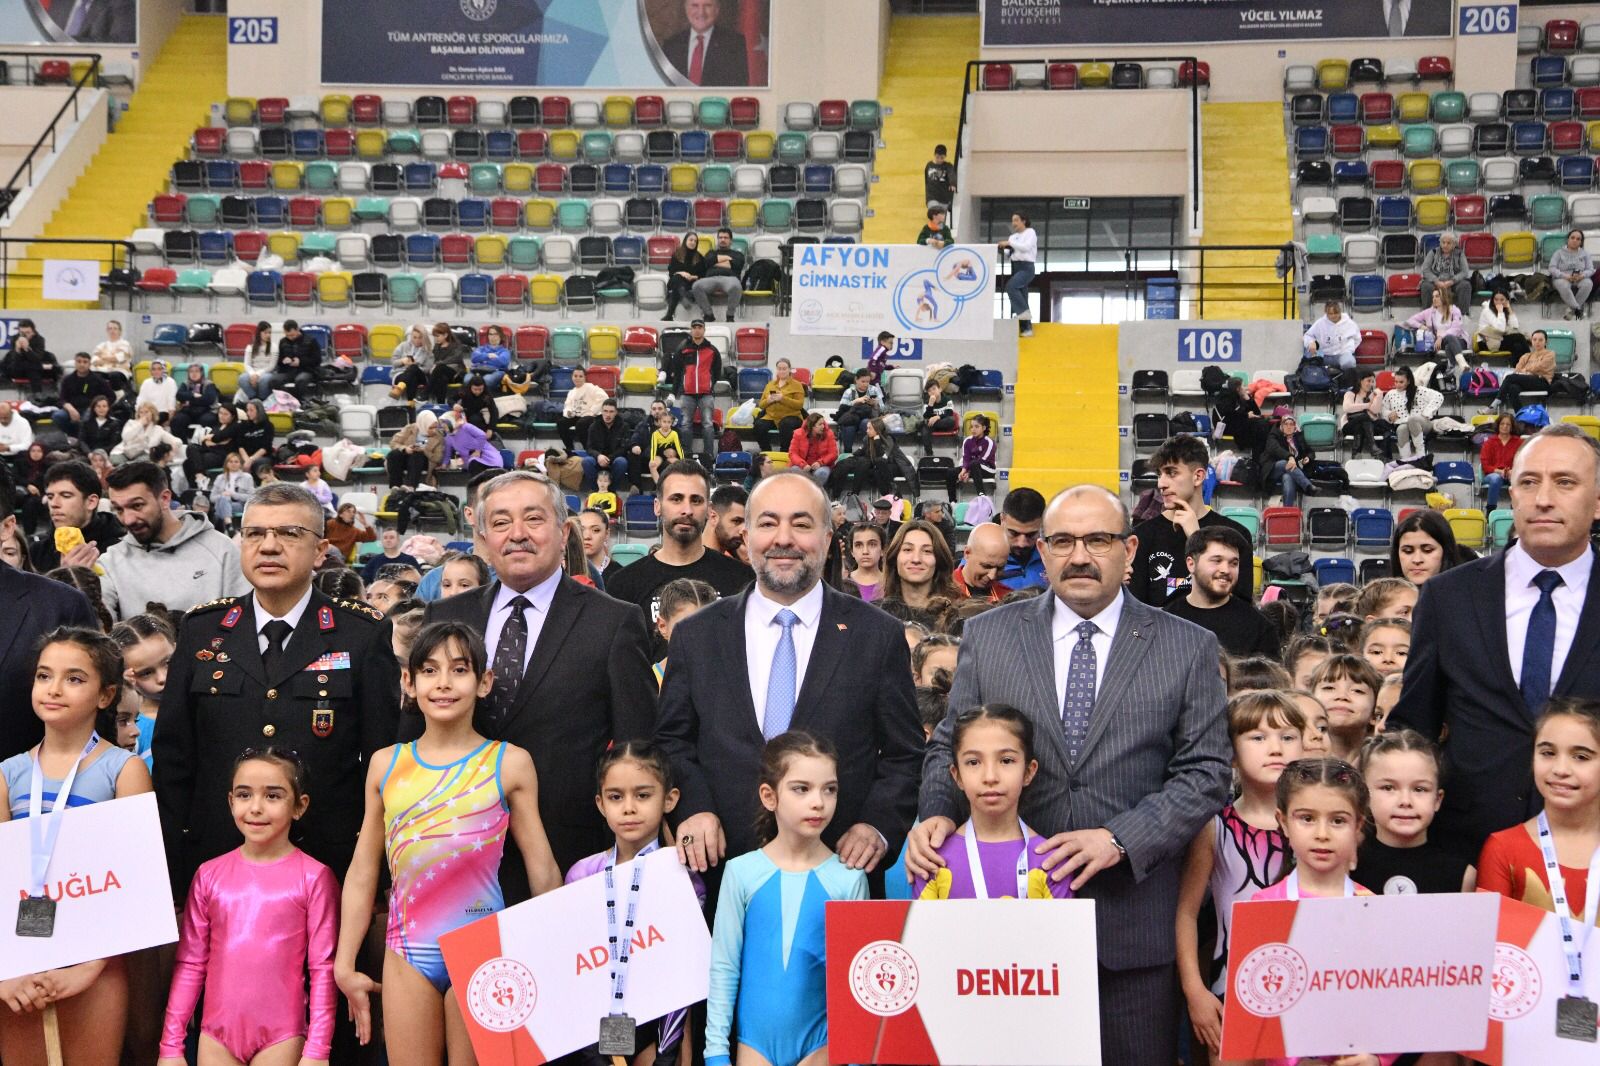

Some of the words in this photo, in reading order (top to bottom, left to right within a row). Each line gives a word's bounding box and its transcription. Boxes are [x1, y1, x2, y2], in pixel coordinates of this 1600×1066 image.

[1001, 7, 1061, 17] BÜYÜKŞEHİR
[1240, 9, 1277, 21] YÜCEL
[1279, 9, 1323, 21] YILMAZ
[1465, 7, 1510, 33] 206
[233, 19, 273, 42] 205
[387, 31, 410, 42] TÜM
[412, 31, 466, 43] ANTRENÖR
[468, 33, 480, 43] VE
[483, 33, 569, 44] SPORCULARIMIZA
[430, 45, 477, 55] BAŞARILAR
[478, 45, 525, 54] DİLİYORUM
[800, 246, 890, 269] AFYON
[799, 271, 887, 289] CİMNASTİK
[1183, 332, 1234, 360] 106
[576, 925, 665, 976] ADNA
[957, 963, 1060, 996] DENİZLİ
[1309, 960, 1485, 992] AFYONKARAHİSAR
